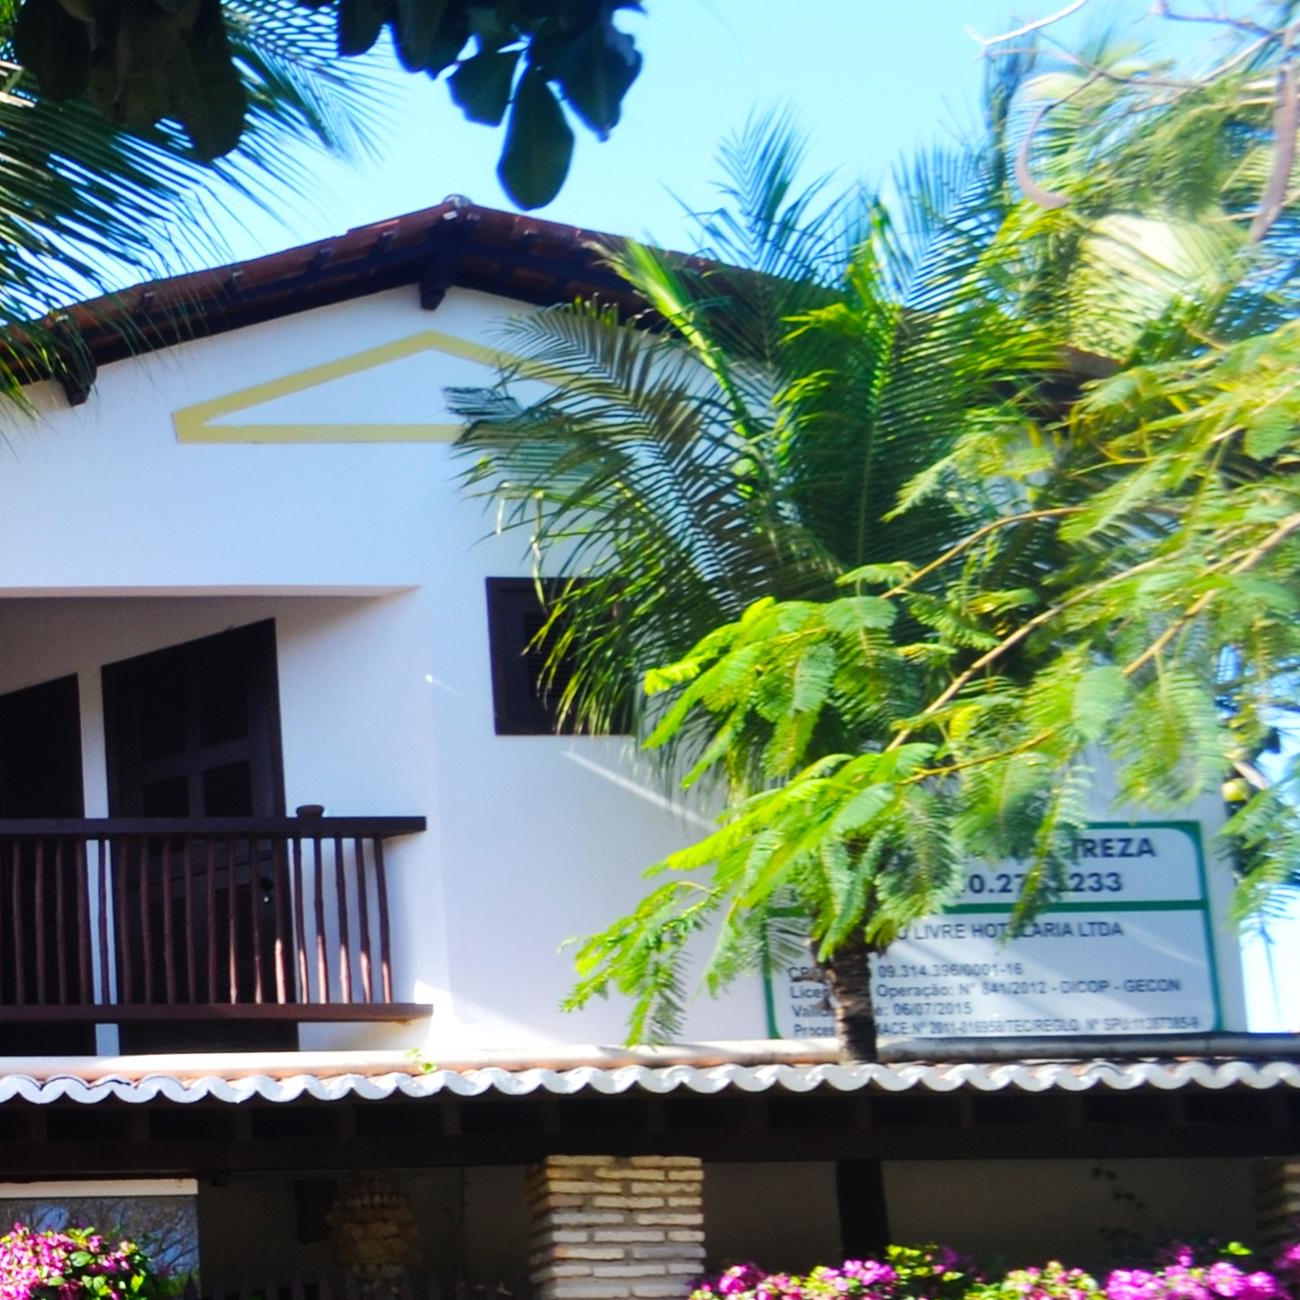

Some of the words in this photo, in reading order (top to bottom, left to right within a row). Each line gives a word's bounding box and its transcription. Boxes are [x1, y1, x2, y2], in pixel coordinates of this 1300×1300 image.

[914, 924, 965, 941] LIVRE
[971, 922, 1074, 939] HOTLARIA
[1078, 921, 1124, 937] LTDA
[1123, 978, 1181, 993] GECON
